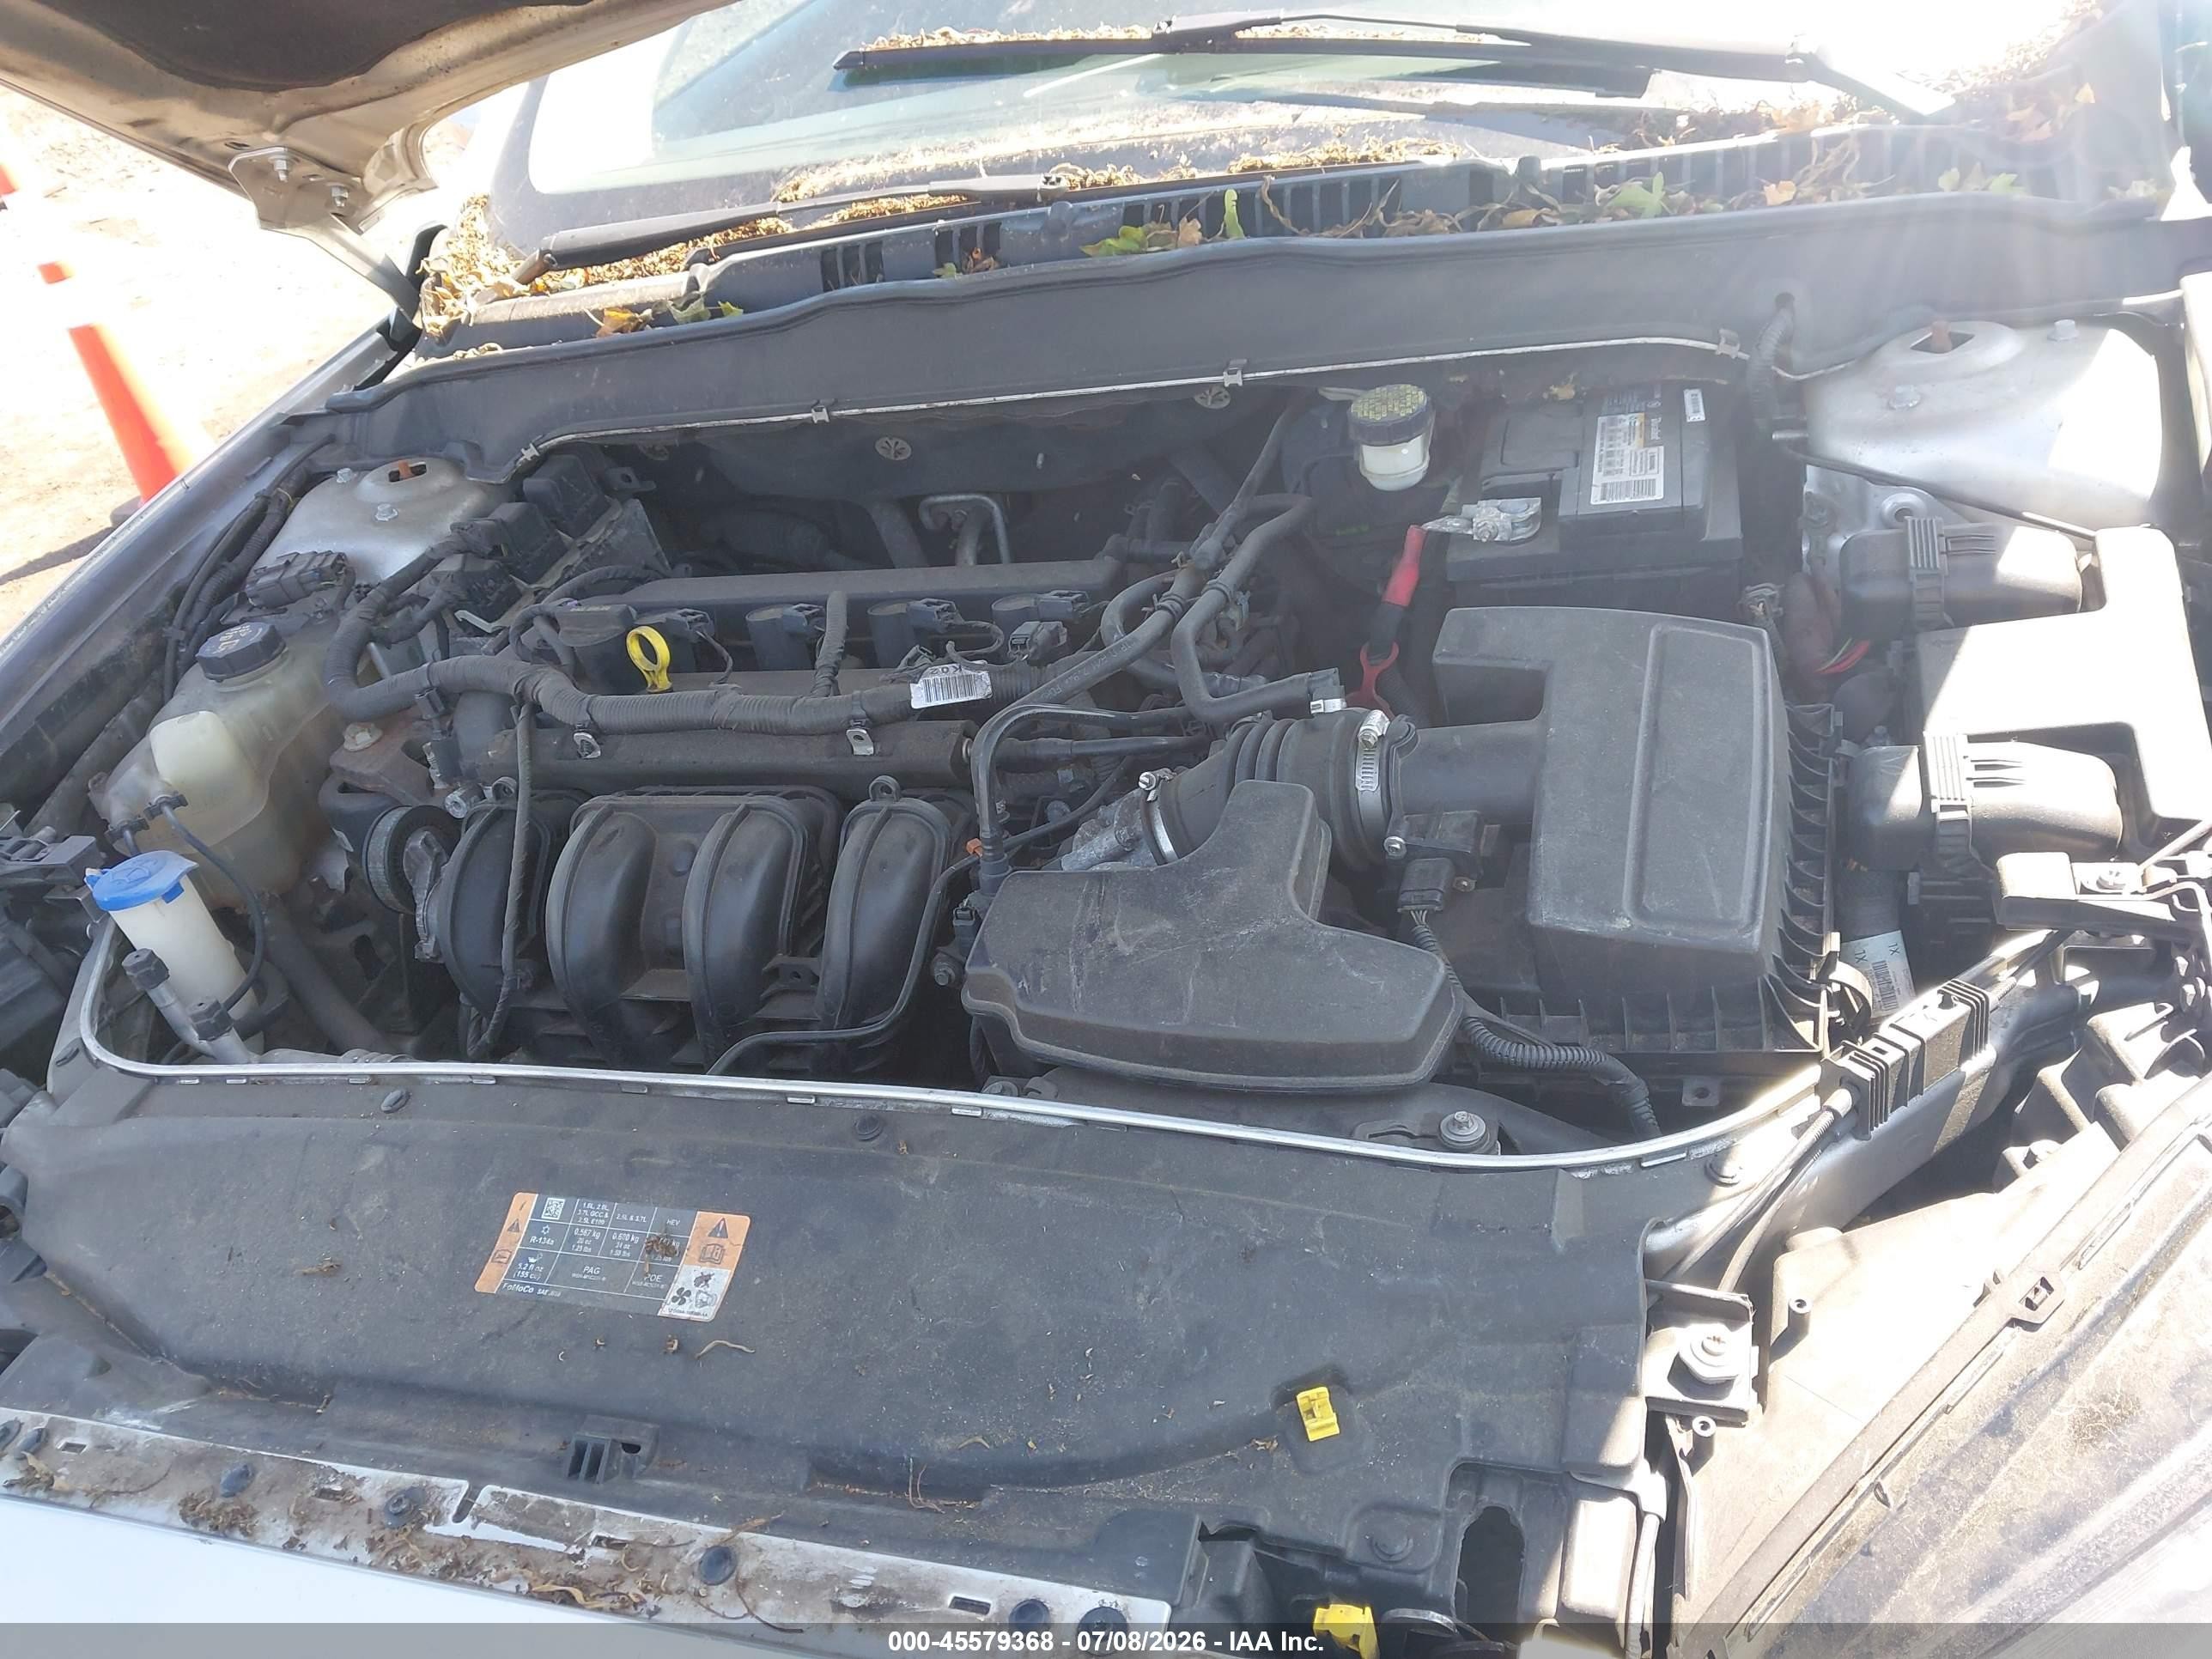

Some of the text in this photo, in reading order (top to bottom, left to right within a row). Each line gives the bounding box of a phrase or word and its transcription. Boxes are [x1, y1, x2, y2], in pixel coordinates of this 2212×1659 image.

[592, 1229, 601, 1240] kg
[630, 1233, 640, 1244] kg
[529, 1236, 555, 1245] R-134a
[582, 1266, 601, 1275] PAG
